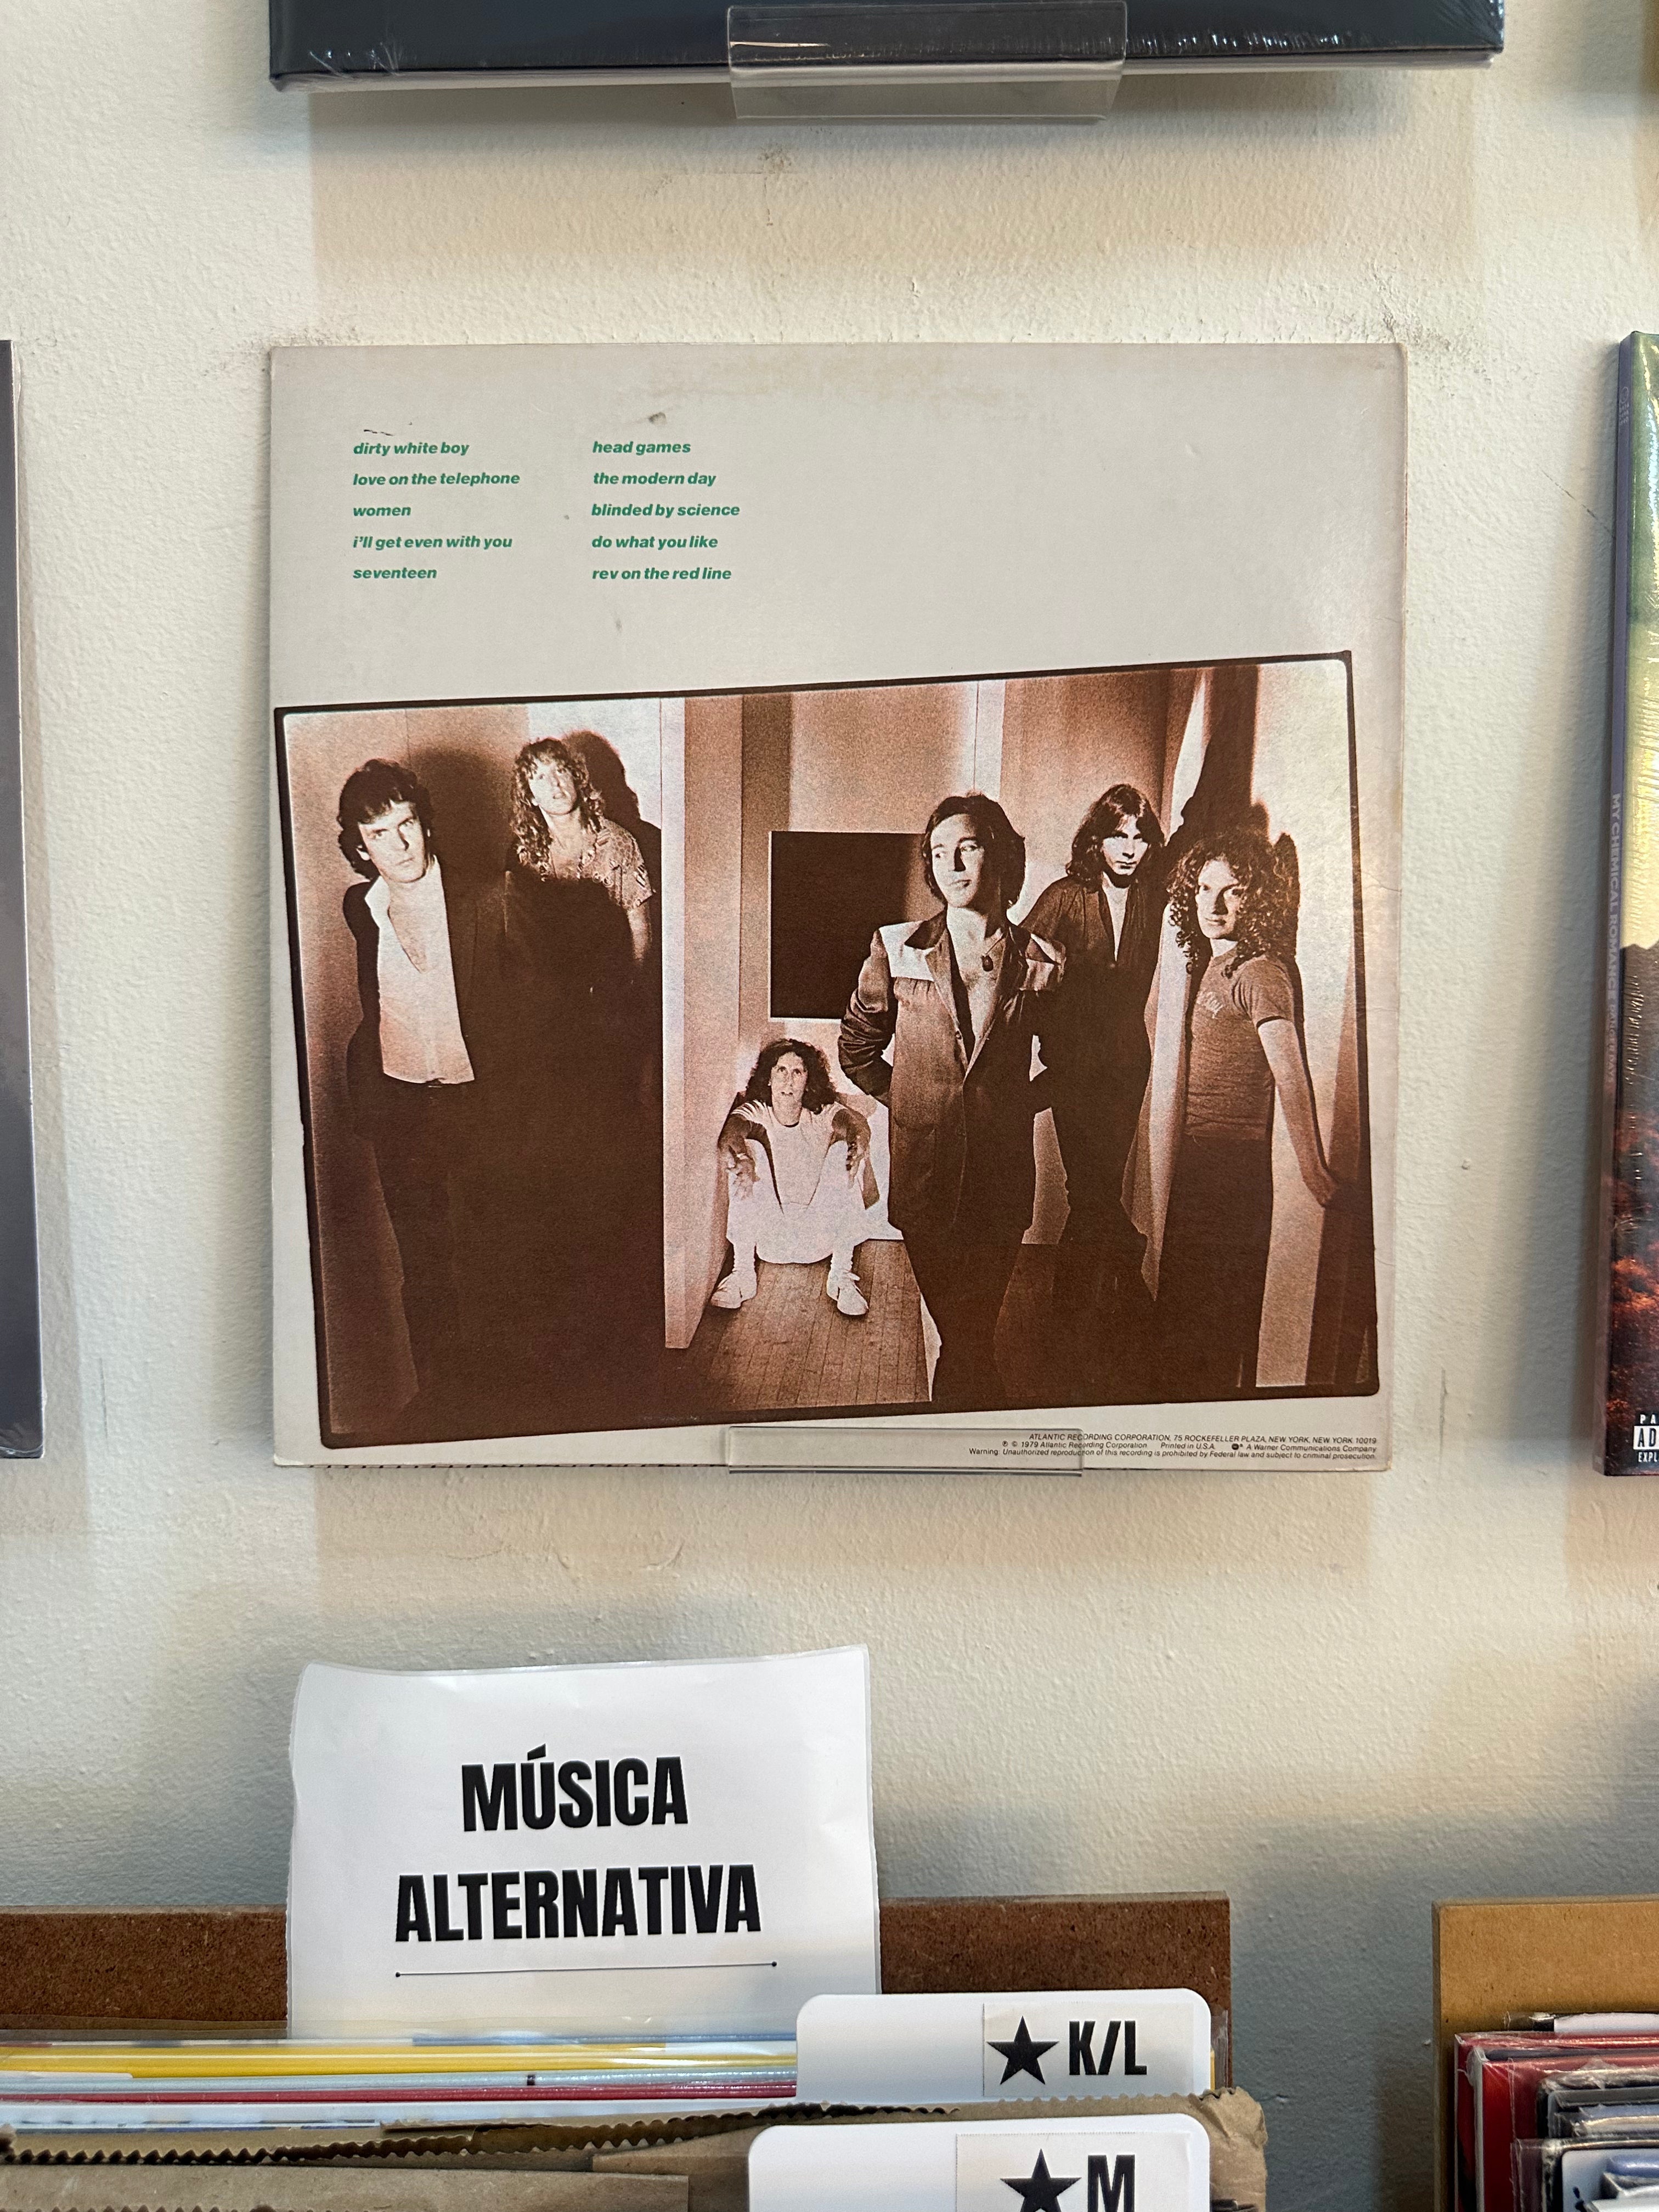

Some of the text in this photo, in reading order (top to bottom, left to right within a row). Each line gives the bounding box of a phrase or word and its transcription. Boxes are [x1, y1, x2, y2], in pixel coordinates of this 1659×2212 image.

[353, 441, 470, 457] dirty white boy
[592, 440, 691, 455] head games
[353, 472, 521, 487] love on the telephone
[593, 472, 717, 487] the modern day
[353, 506, 411, 517] women
[591, 504, 741, 519] blinded by science
[375, 537, 403, 551] get
[404, 538, 443, 549] even
[446, 535, 481, 548] with
[484, 538, 513, 550] you
[591, 535, 719, 551] do what you like
[353, 567, 438, 580] seventeen
[592, 567, 732, 580] rev on the red line
[1611, 793, 1621, 819] MY
[1610, 822, 1620, 912] CHEMICAL
[1607, 915, 1618, 1000] ROMANCE
[1114, 1434, 1171, 1442] CORPORATION,
[1280, 1444, 1341, 1452] Communications
[1342, 1444, 1377, 1453] Company
[461, 1743, 689, 1832] MÚSICA
[395, 1864, 761, 1943] ALTERNATIVA
[1069, 2020, 1147, 2076] K/L
[1087, 2154, 1135, 2212] M
